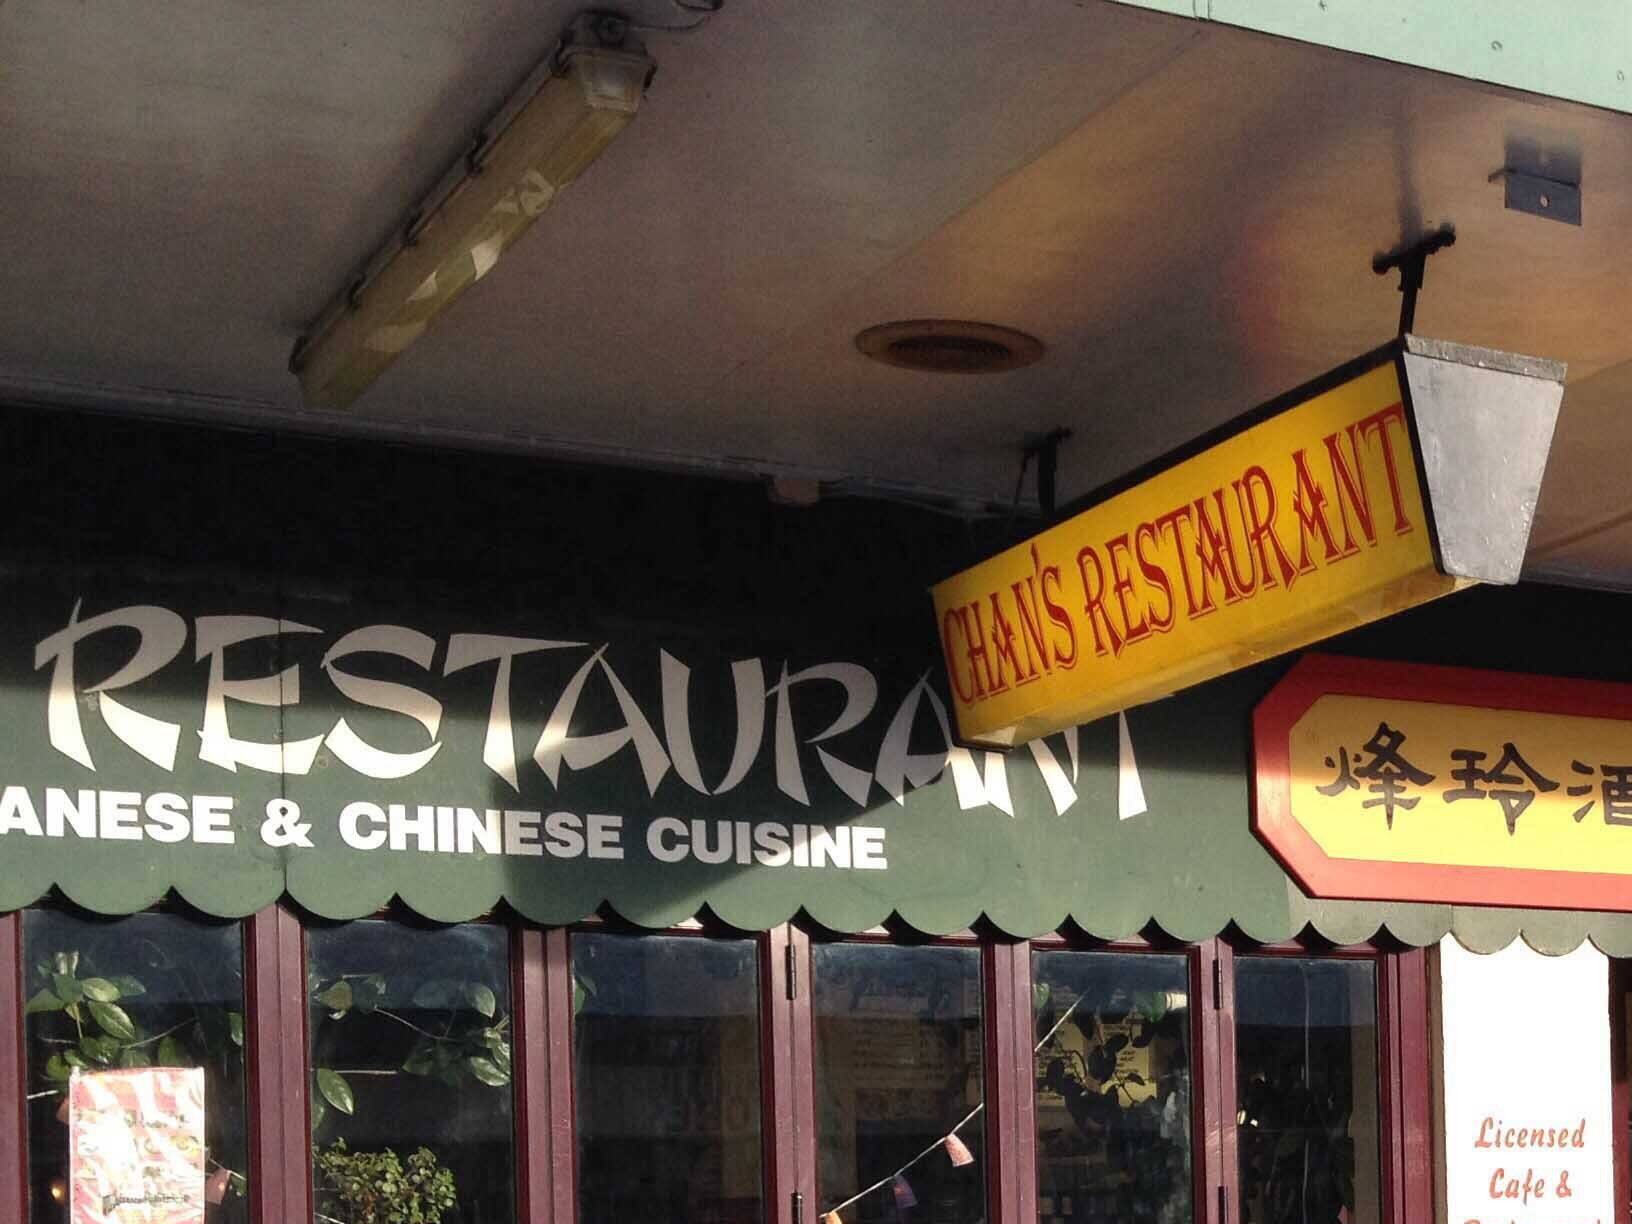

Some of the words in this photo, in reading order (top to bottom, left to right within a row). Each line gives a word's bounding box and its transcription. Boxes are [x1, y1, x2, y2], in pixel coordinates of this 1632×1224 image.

[942, 532, 1078, 706] CHAN'S
[1077, 402, 1413, 660] RESTAURANT
[260, 797, 315, 850] &
[339, 803, 625, 860] CHINESE
[647, 816, 887, 870] CUISINE
[1474, 1117, 1586, 1148] Licensed
[1489, 1168, 1545, 1206] Cafe
[1556, 1170, 1573, 1198] &
